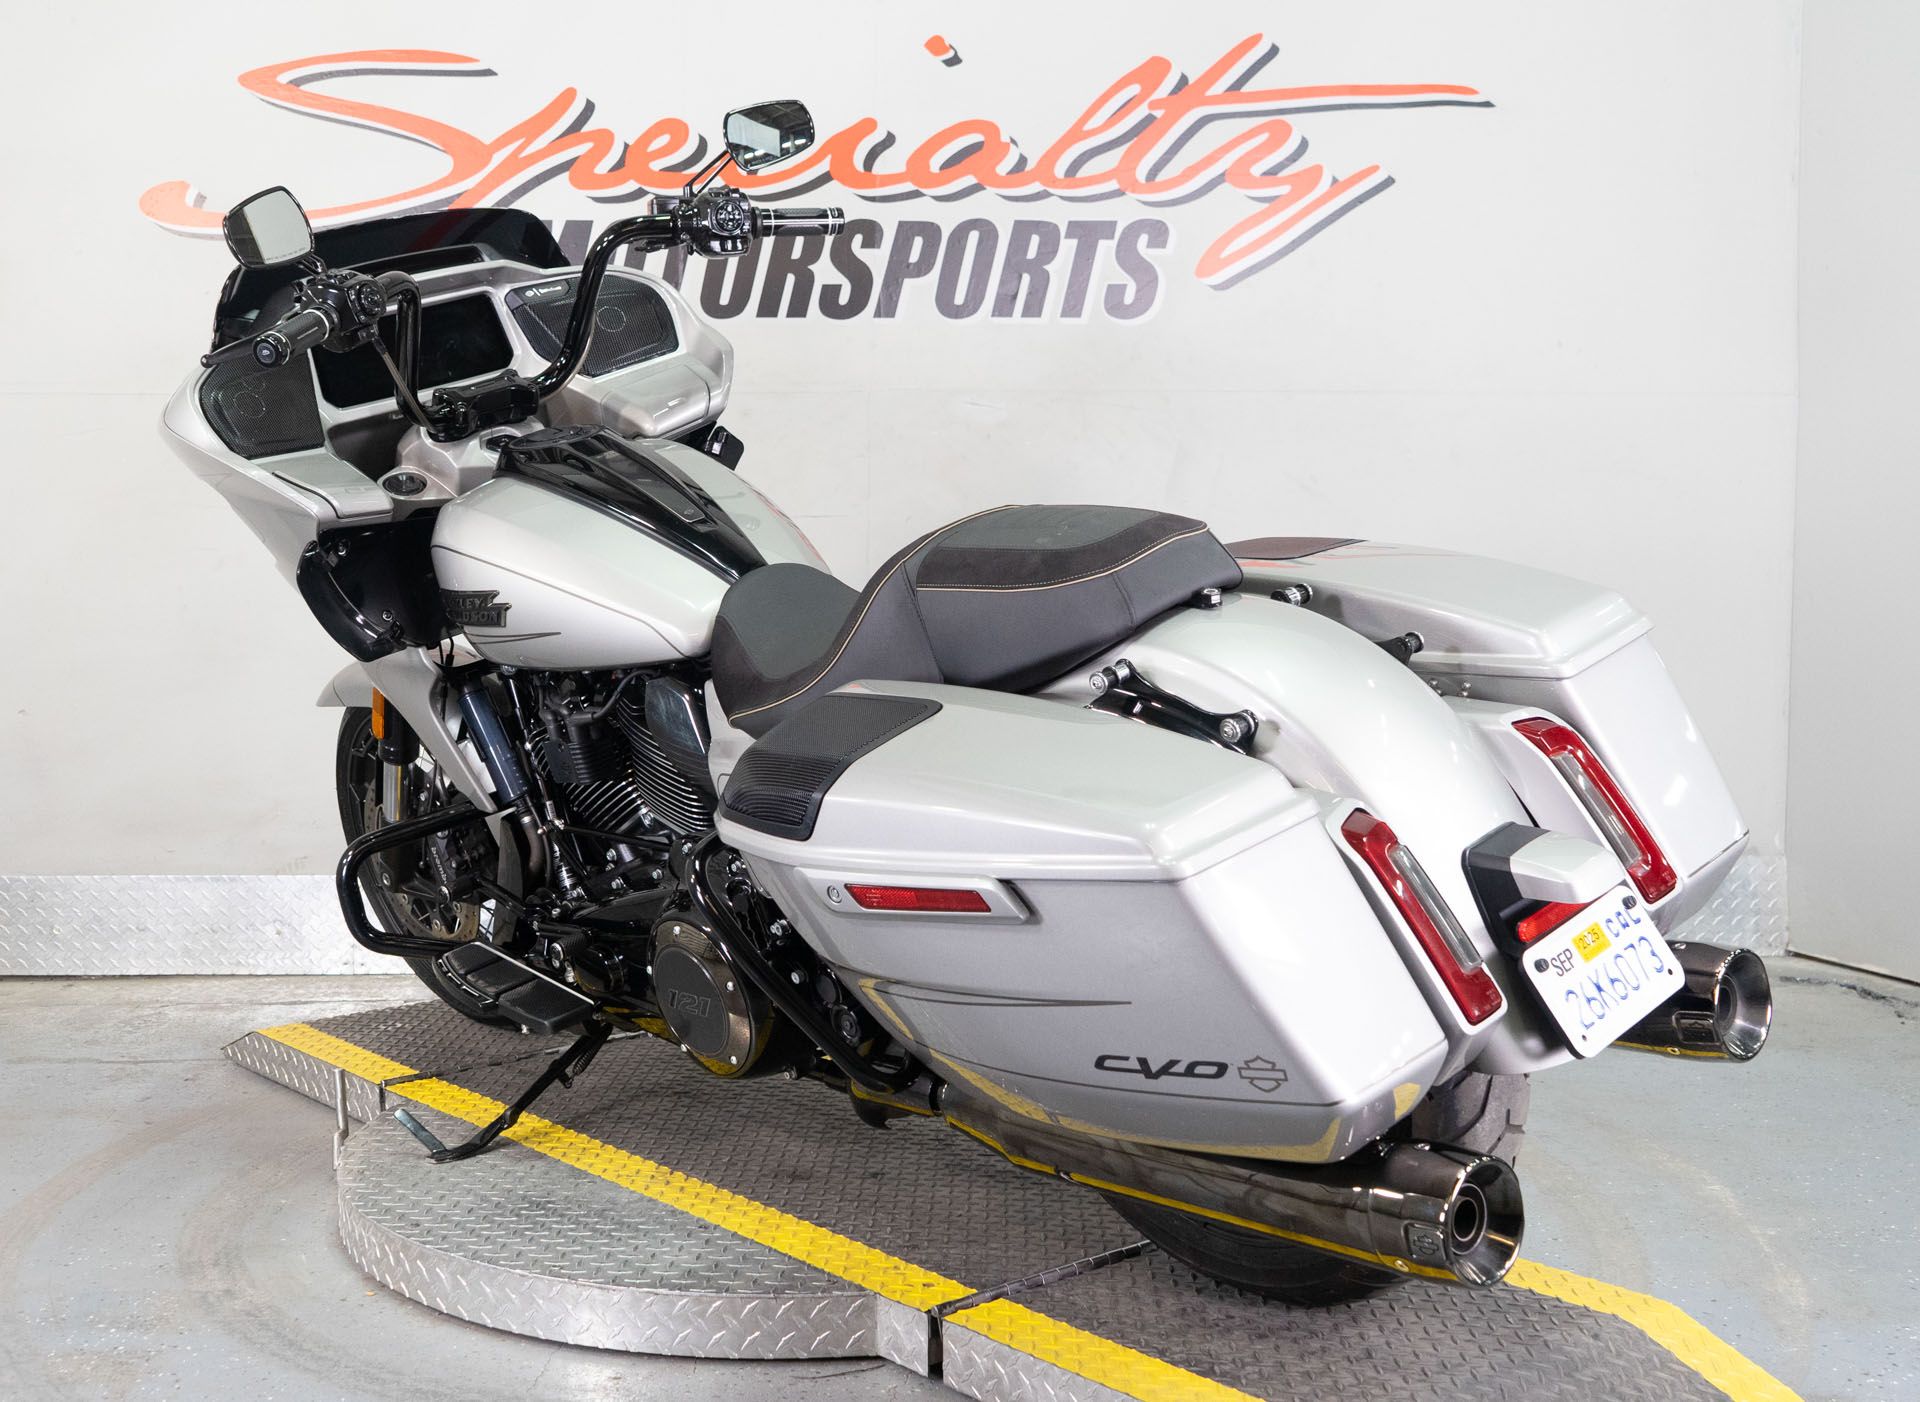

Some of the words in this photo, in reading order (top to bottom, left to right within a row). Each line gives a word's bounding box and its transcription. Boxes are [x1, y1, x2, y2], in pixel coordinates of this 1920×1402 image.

[541, 217, 1170, 321] ORSPORTS
[1550, 948, 1574, 977] SEP
[1578, 928, 1600, 950] 2025
[669, 989, 711, 1017] 121
[1565, 936, 1663, 1030] 26K6073
[1094, 1054, 1229, 1080] CVO
